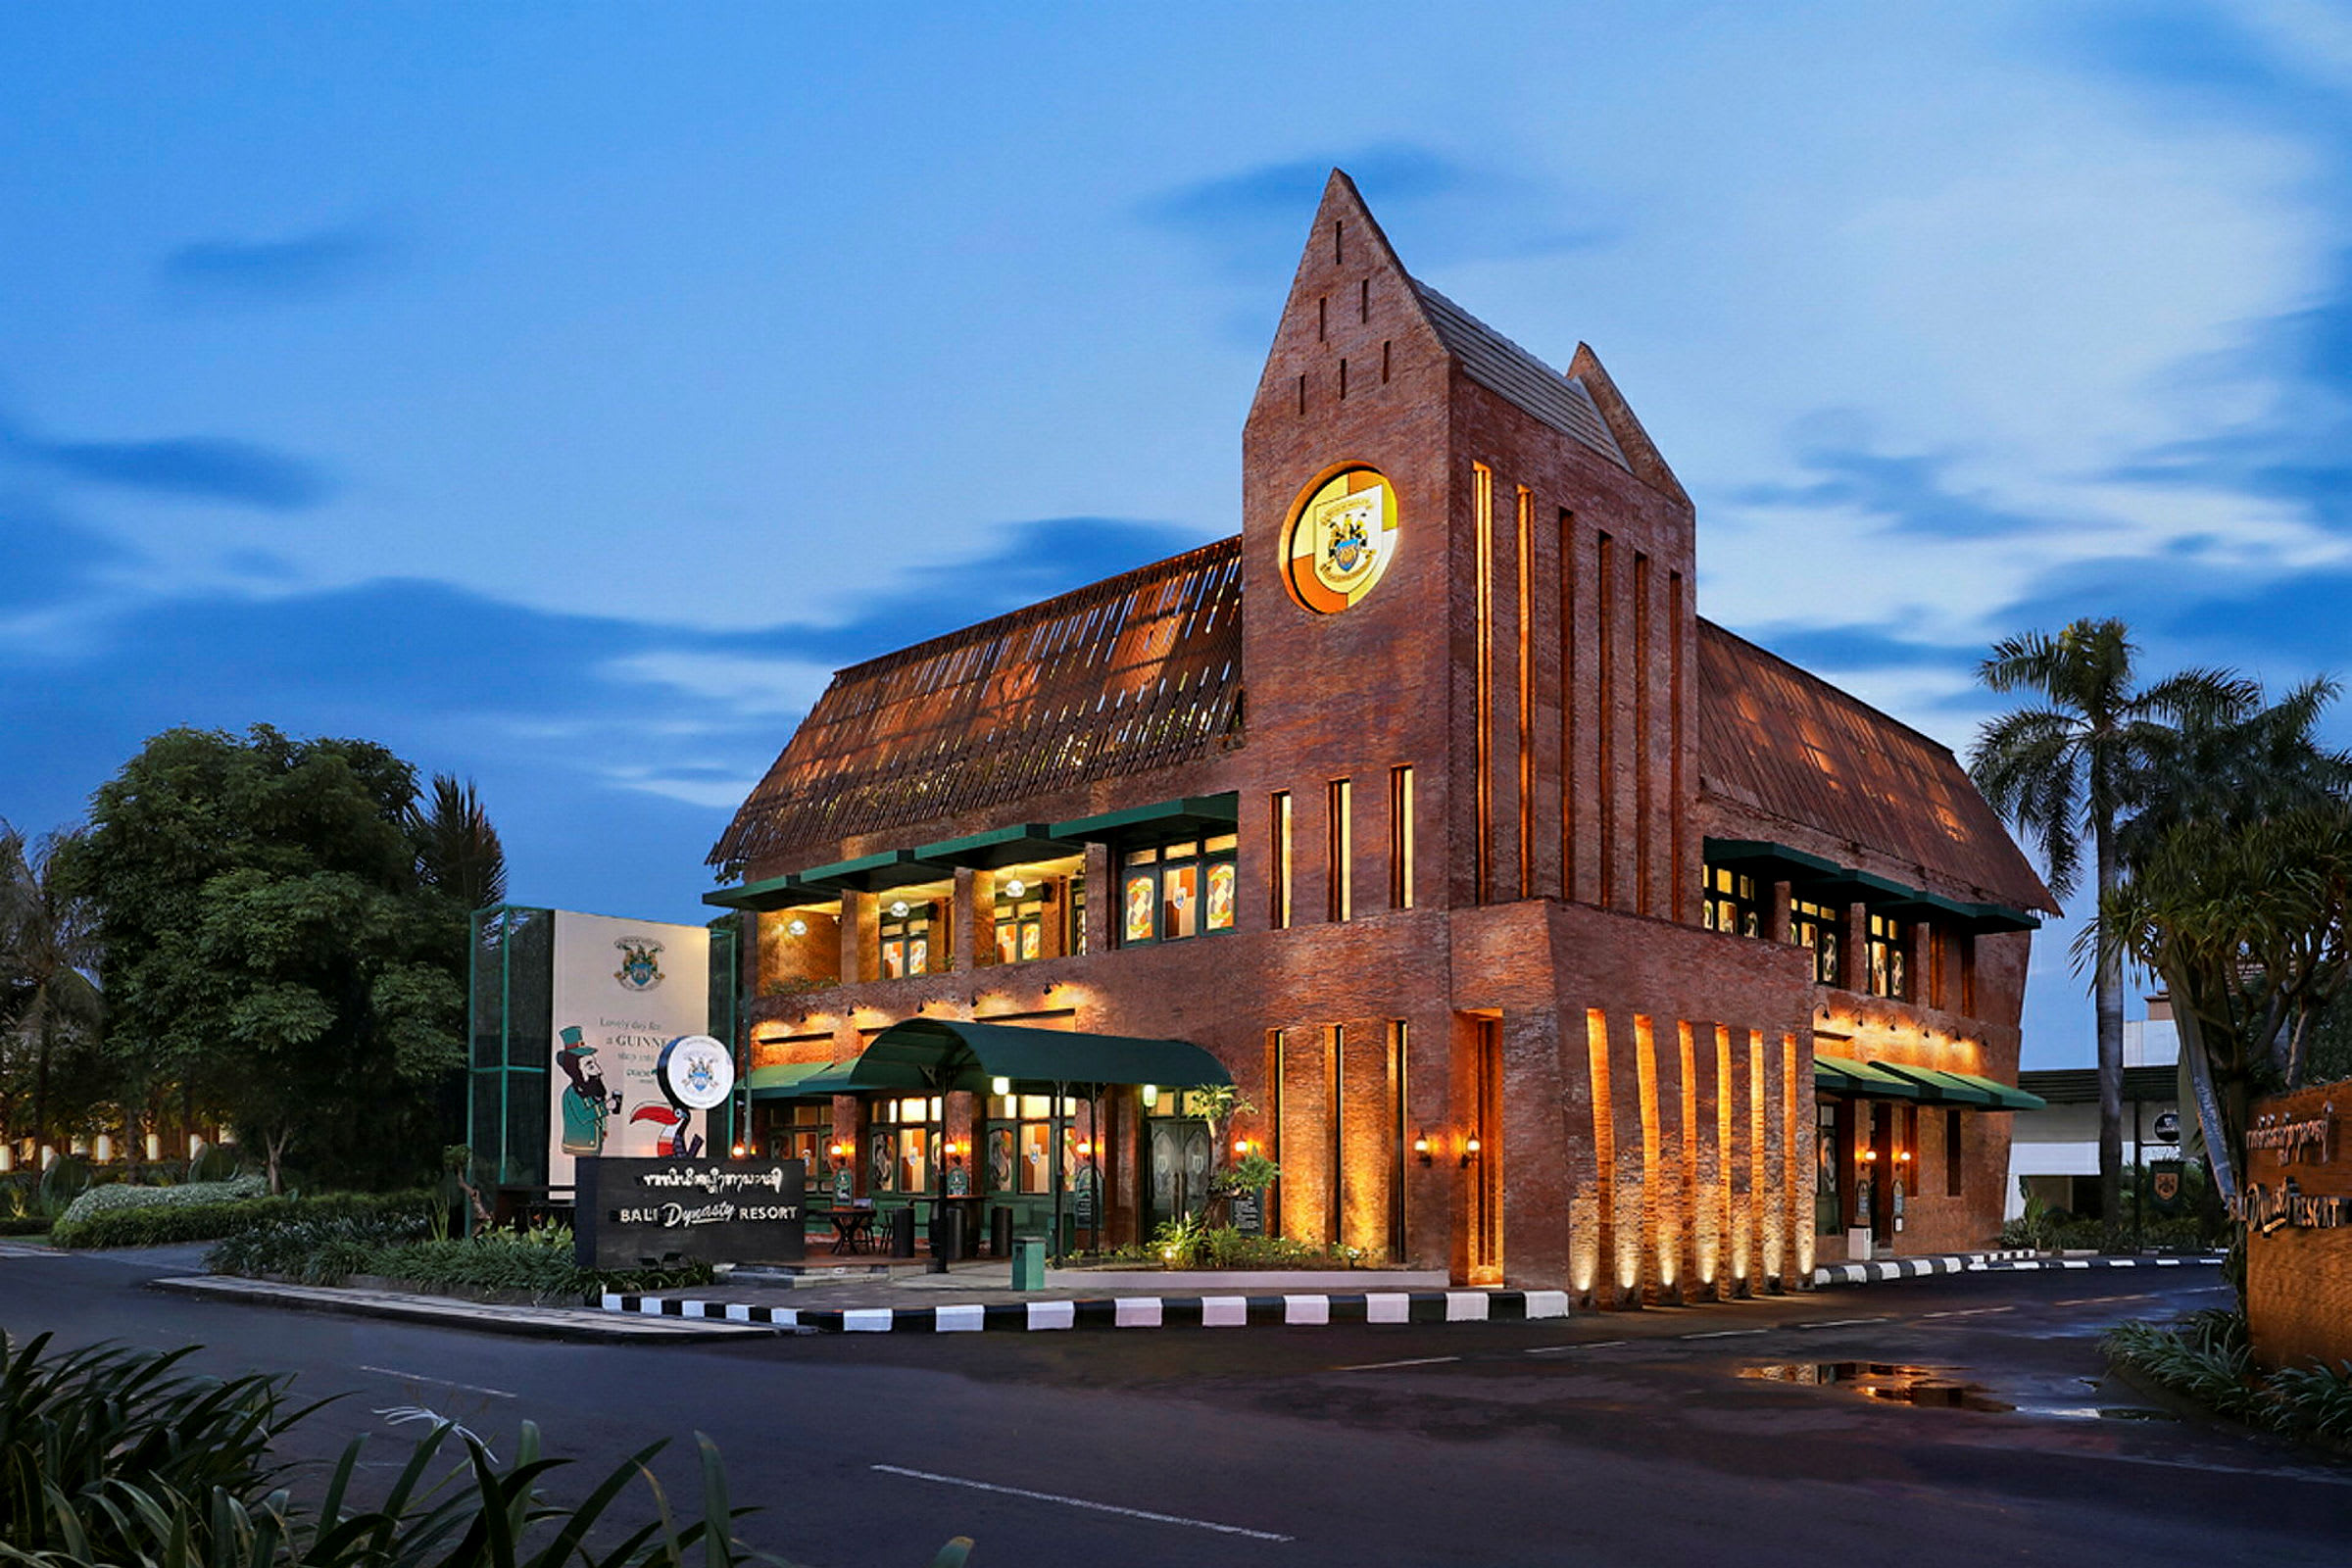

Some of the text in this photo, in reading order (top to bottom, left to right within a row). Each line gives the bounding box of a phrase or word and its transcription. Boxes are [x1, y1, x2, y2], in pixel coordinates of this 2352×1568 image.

[615, 1034, 666, 1048] GUINNE
[619, 1200, 799, 1227] BALI Dynasty RESORT
